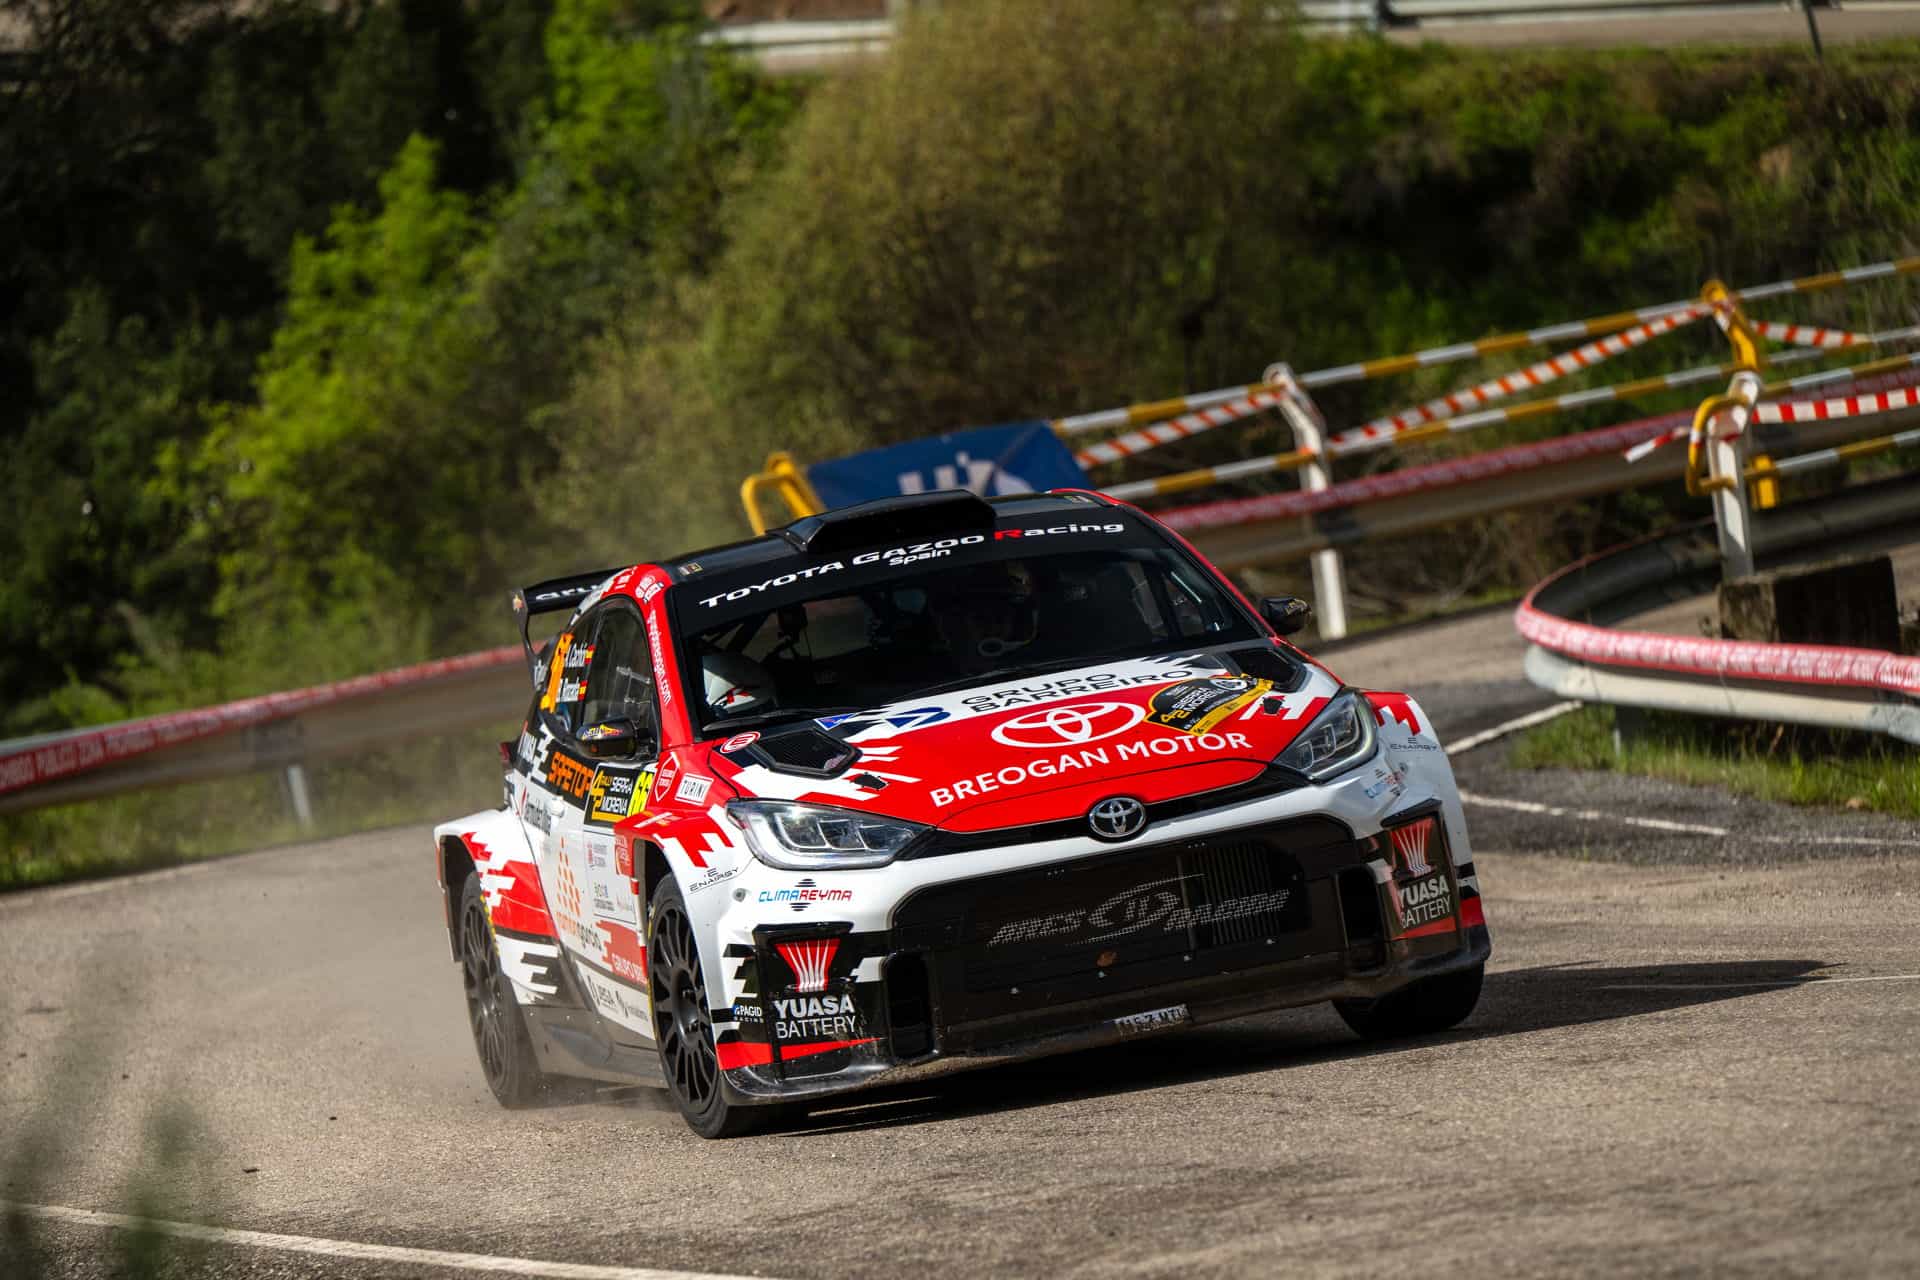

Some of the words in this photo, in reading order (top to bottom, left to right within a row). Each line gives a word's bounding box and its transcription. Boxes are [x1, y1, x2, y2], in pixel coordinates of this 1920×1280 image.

[700, 561, 844, 608] TOYOTA
[852, 533, 985, 567] GAZOO
[994, 521, 1125, 542] Racing
[889, 548, 951, 568] Spain
[961, 673, 1117, 706] GRUPO
[969, 670, 1193, 713] BARREIRO
[1160, 709, 1191, 723] 42
[929, 748, 1110, 808] BREOGAN
[1116, 732, 1254, 761] MOTOR
[680, 779, 707, 799] TURINI
[689, 867, 739, 892] ENAIRGY
[1397, 875, 1450, 908] YUASA
[758, 889, 853, 903] CLIMAREYMA
[1399, 896, 1451, 929] BATTERY
[739, 1004, 763, 1017] PAGID
[773, 994, 856, 1019] YUASA
[775, 1015, 857, 1039] BATTERY
